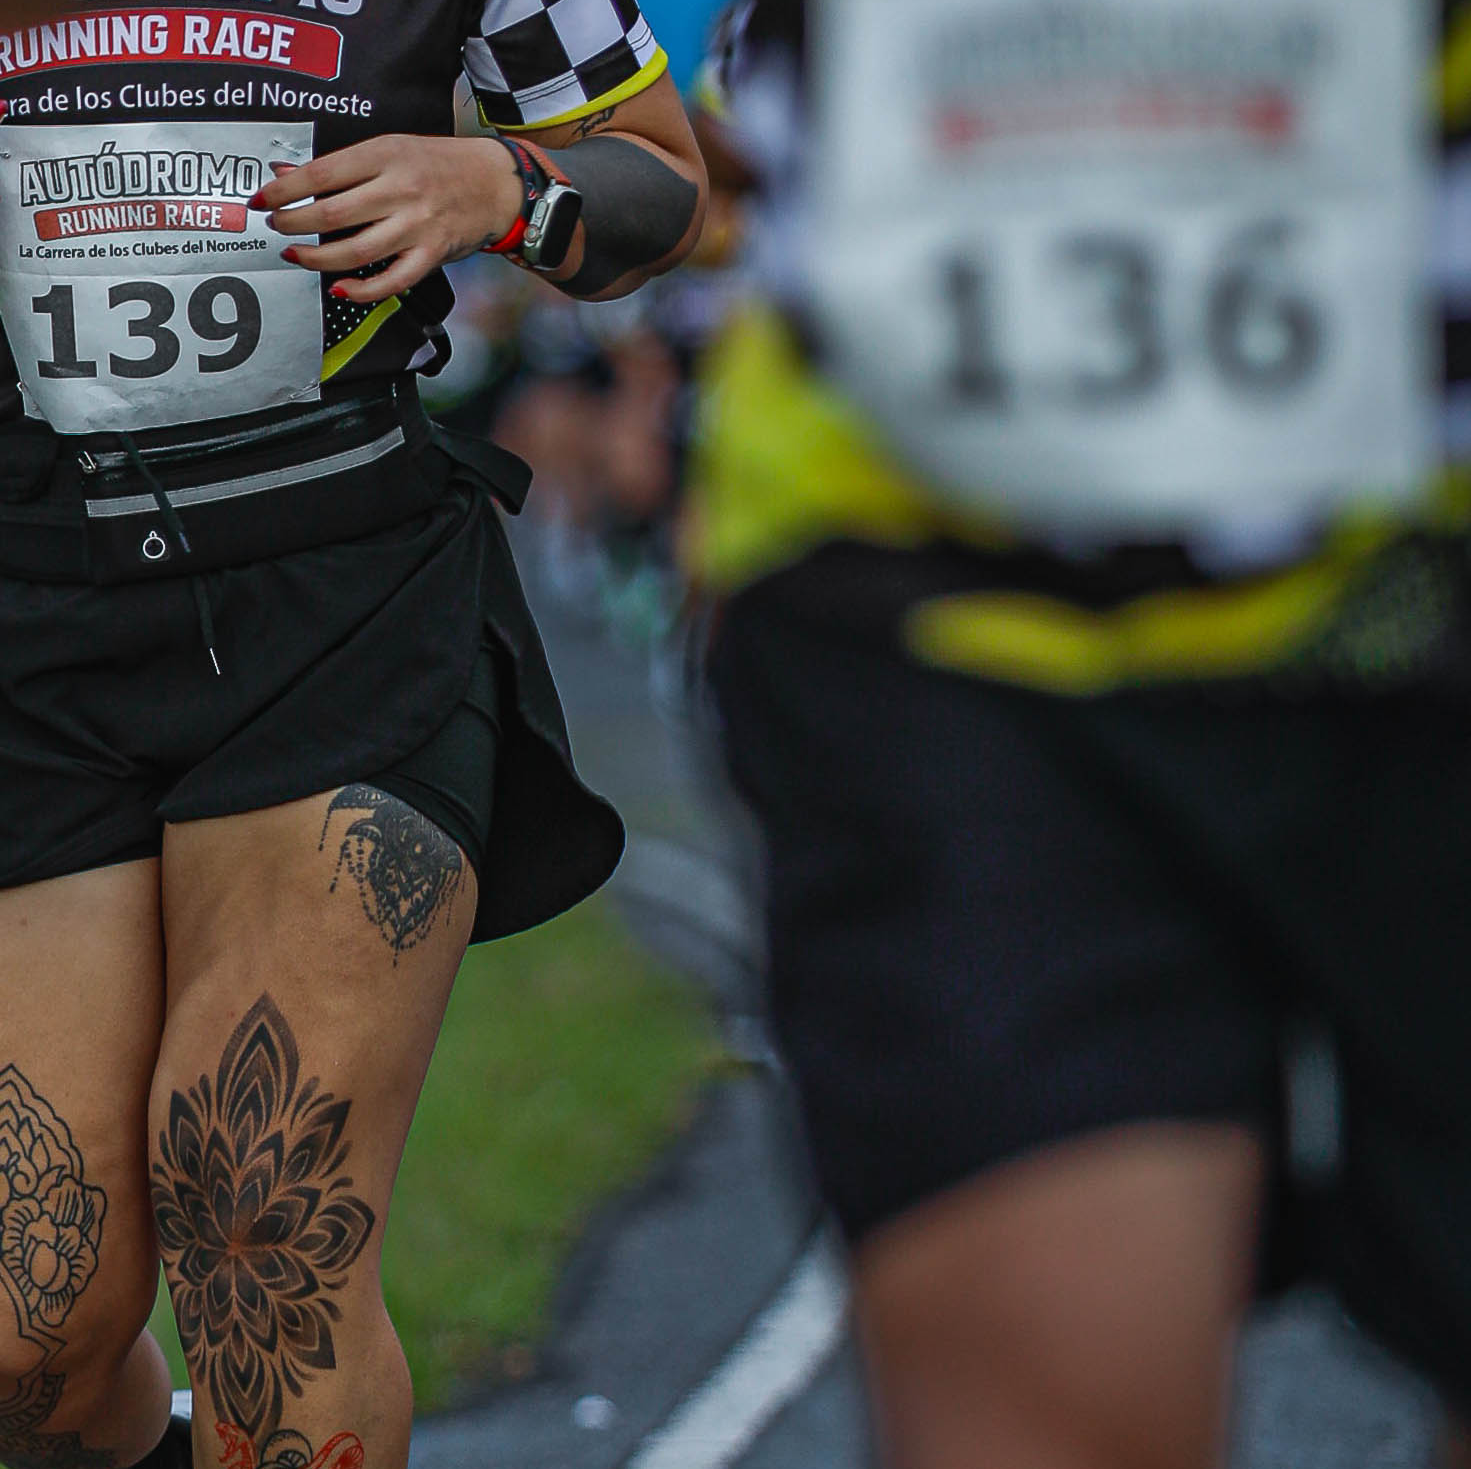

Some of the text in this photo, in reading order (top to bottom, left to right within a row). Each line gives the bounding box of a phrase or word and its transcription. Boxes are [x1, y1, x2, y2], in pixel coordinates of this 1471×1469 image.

[182, 15, 295, 65] RACE
[4, 81, 372, 117] ra de los Clubes del Noroeste
[20, 141, 262, 207] AUTÓDROMO
[56, 204, 223, 236] RUNNING RACE
[19, 238, 267, 259] La Carrera de los Clubes del Noroeste
[31, 275, 263, 379] 139
[931, 215, 1325, 415] 136
